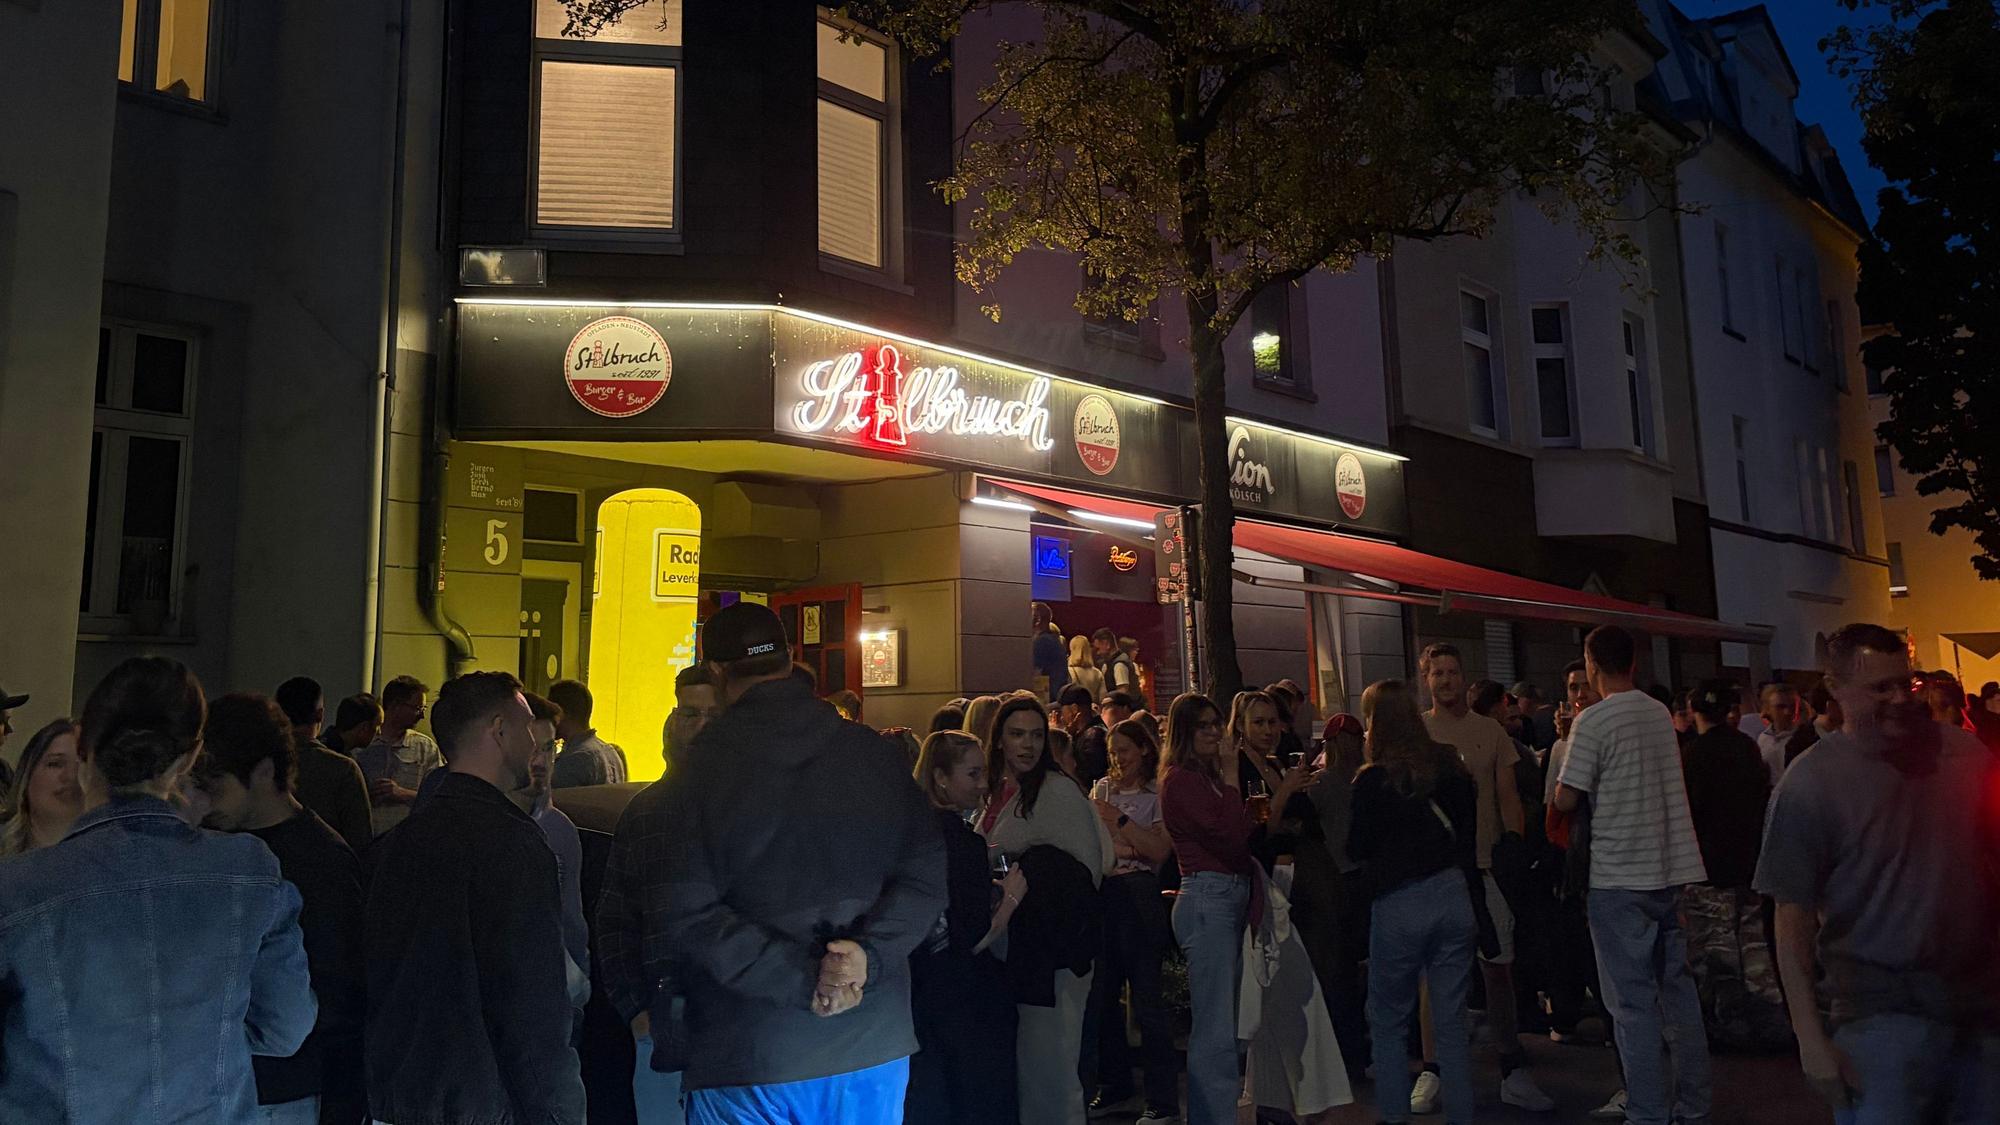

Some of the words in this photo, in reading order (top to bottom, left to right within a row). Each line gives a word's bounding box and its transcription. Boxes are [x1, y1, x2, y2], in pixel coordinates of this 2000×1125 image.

[620, 323, 652, 339] NEUSTADT
[583, 383, 616, 401] Burger
[626, 393, 646, 406] Bar
[484, 518, 509, 566] 5
[747, 643, 775, 656] DUCKS
